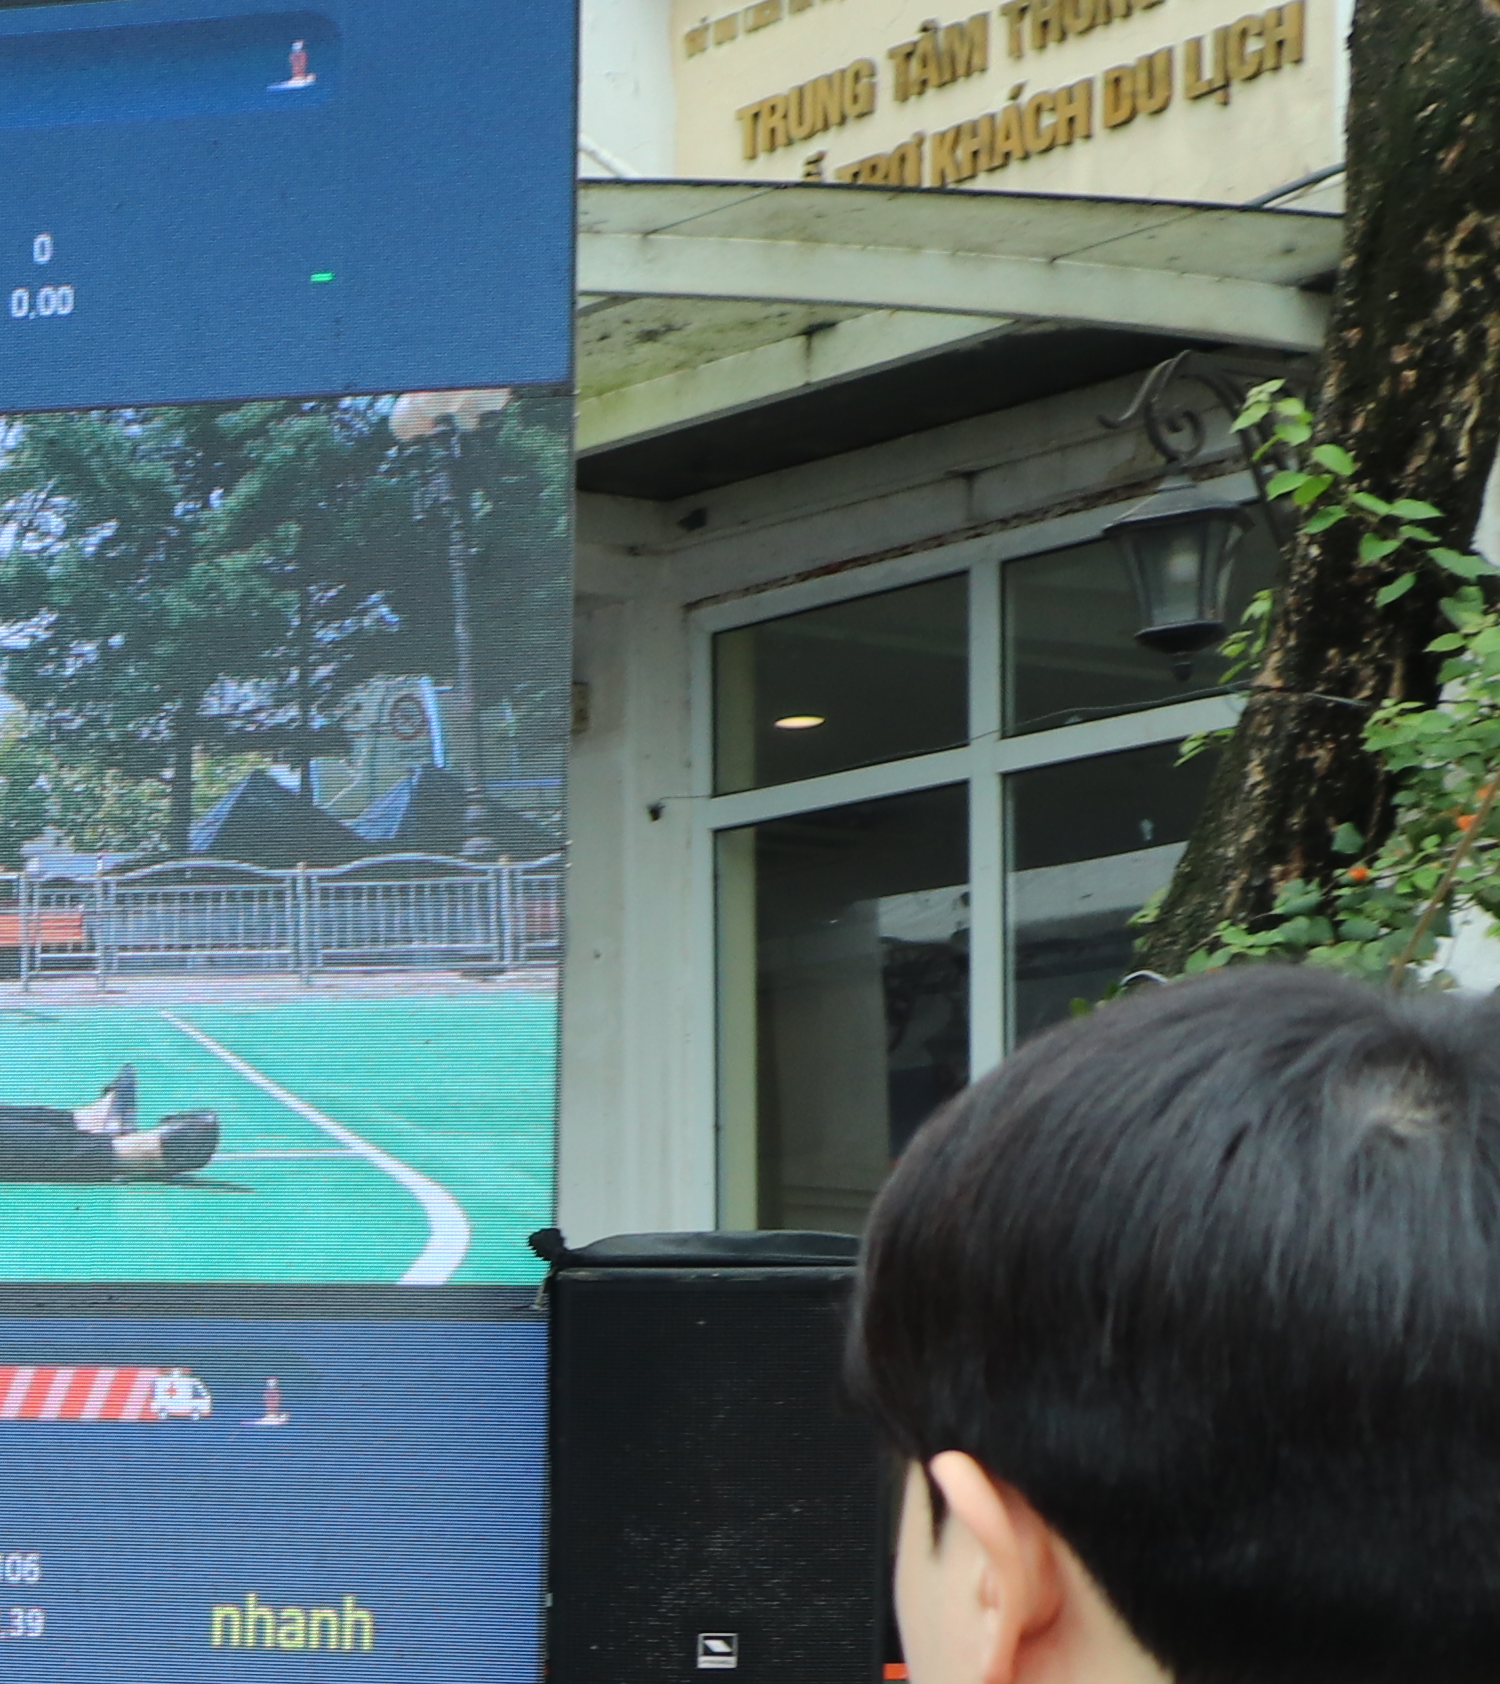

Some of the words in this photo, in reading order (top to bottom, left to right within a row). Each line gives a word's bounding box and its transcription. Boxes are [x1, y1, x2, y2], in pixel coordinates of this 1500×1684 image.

[736, 56, 877, 161] TRUNG
[888, 17, 990, 102] TÂM
[930, 79, 1095, 188] KHÁCH
[1103, 45, 1175, 129] DU
[1183, 1, 1306, 107] LỊCH
[32, 233, 53, 265] 0
[211, 1591, 375, 1652] nhanh
